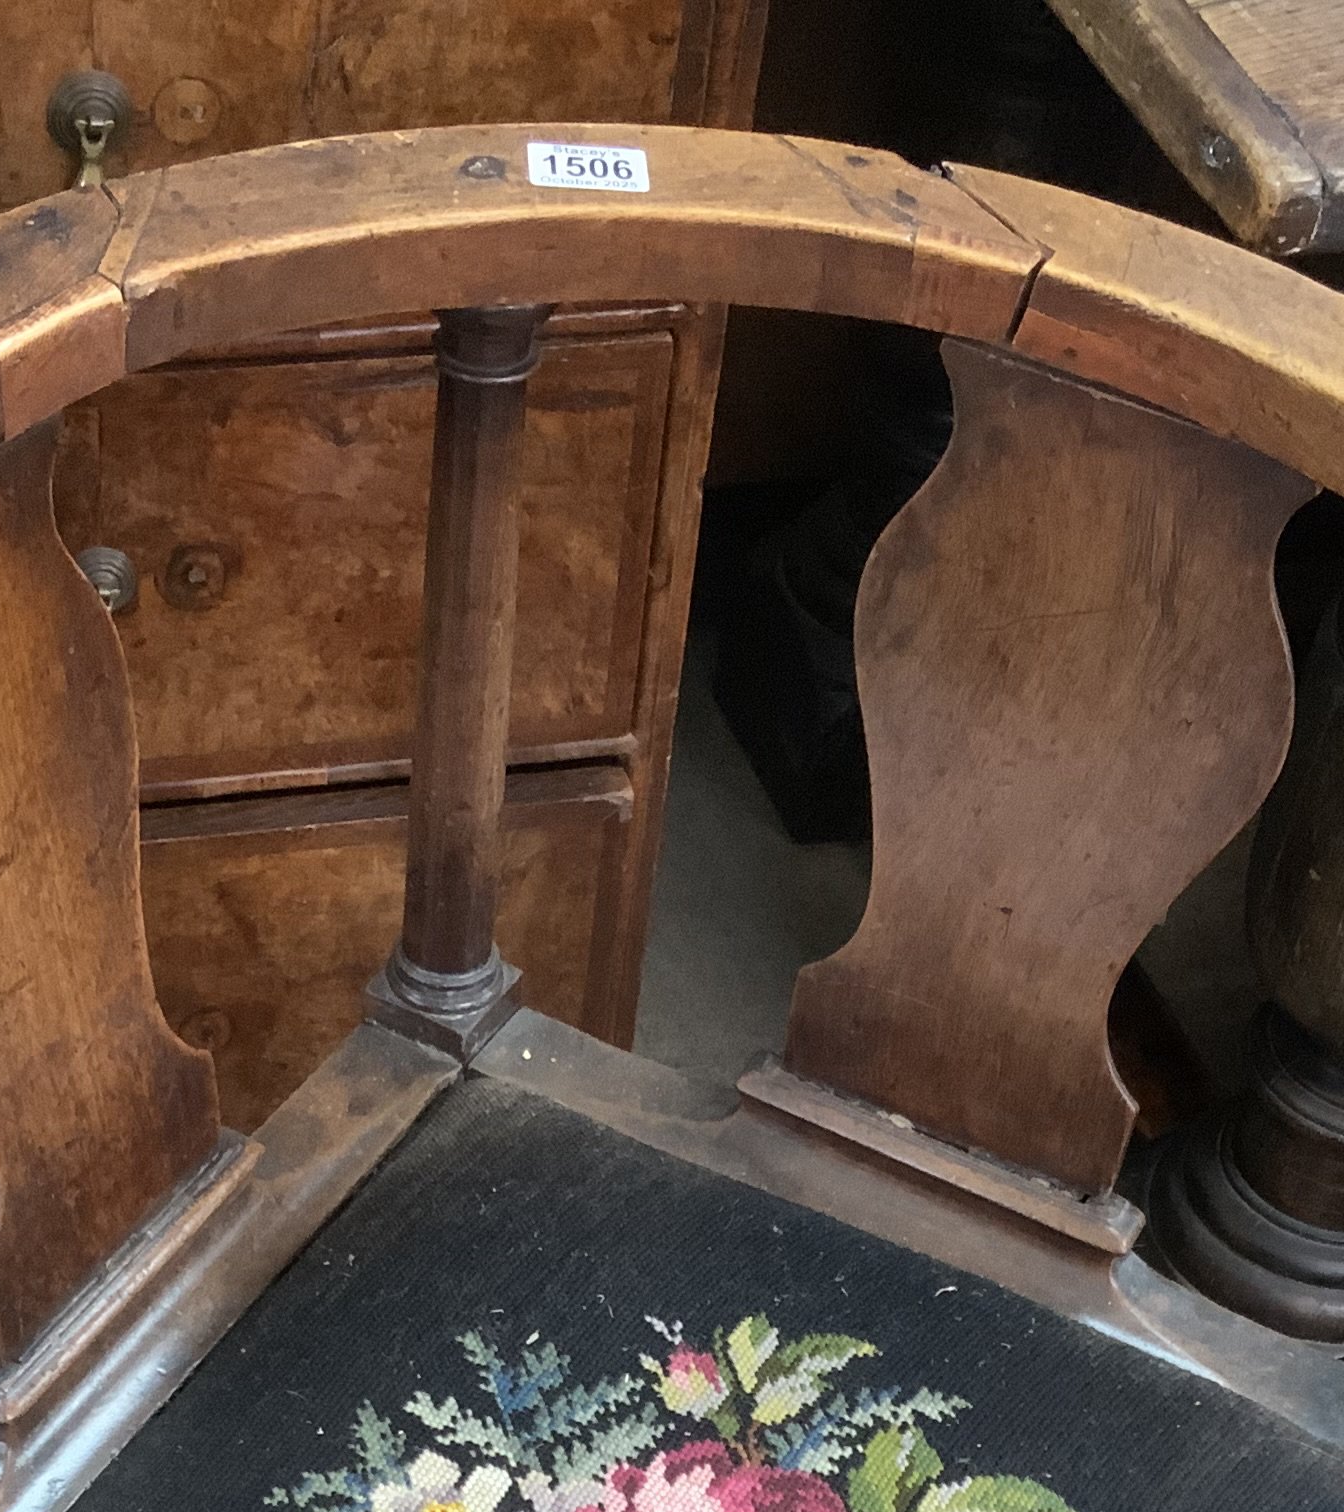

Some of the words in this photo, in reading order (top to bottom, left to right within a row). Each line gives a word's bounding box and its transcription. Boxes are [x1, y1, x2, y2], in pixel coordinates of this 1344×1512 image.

[553, 145, 621, 158] Stacey's
[543, 154, 633, 180] 1506
[540, 175, 598, 186] October
[604, 178, 638, 189] 2025
